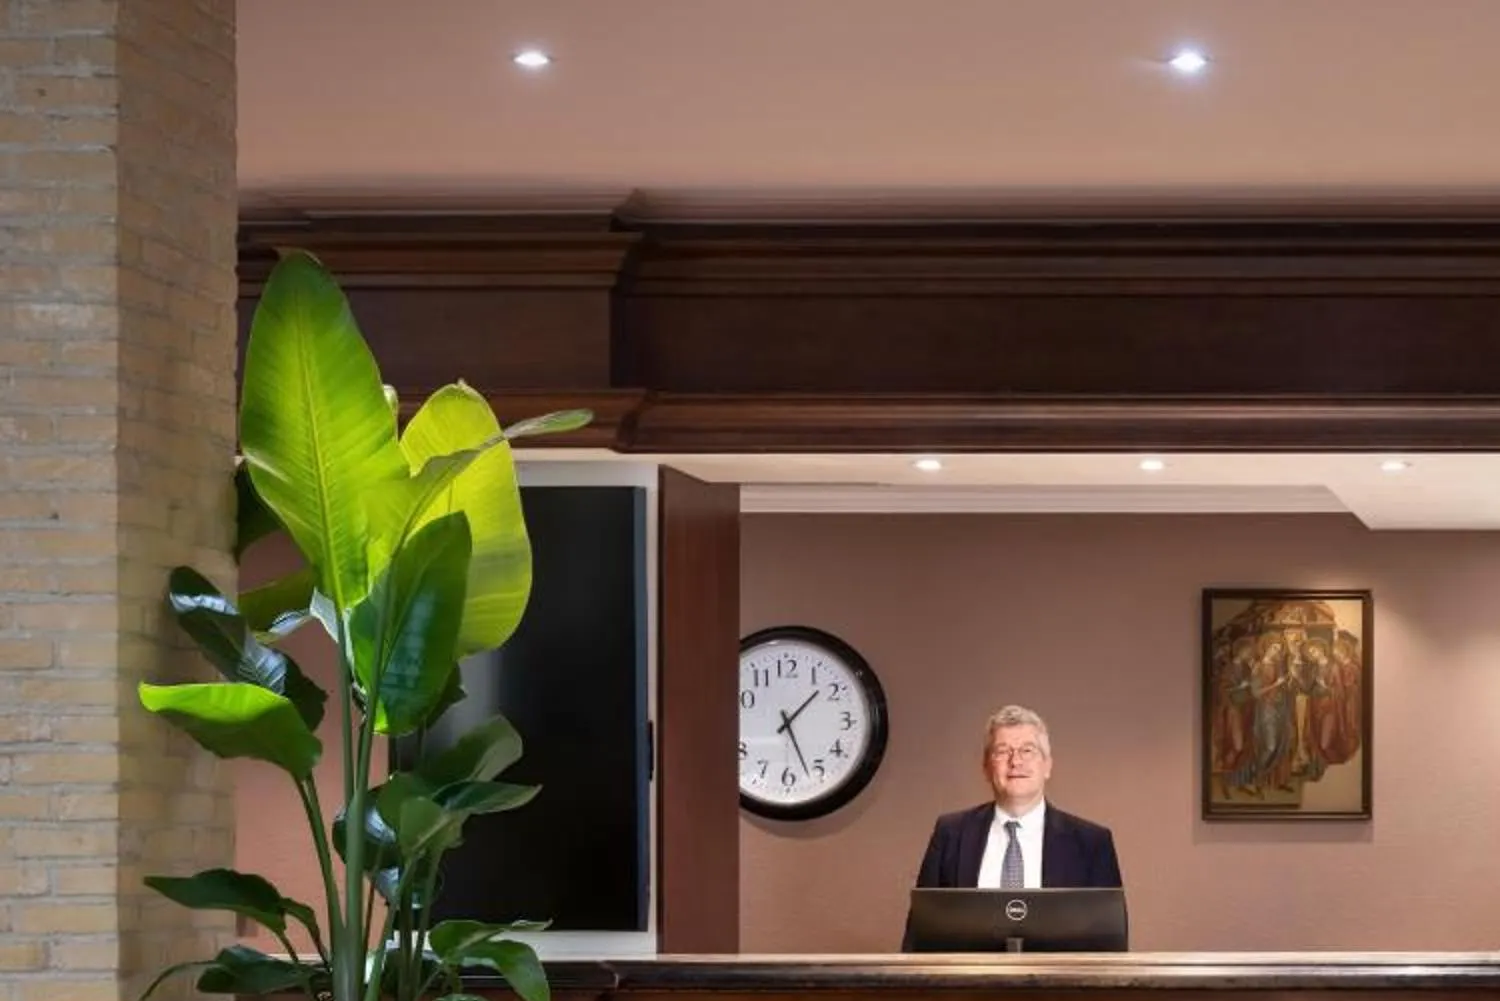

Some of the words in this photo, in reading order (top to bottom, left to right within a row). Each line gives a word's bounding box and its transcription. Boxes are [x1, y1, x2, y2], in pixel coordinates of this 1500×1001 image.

[753, 668, 769, 688] 11
[777, 659, 799, 678] 12
[811, 666, 817, 685] 1
[741, 689, 755, 709] 0
[827, 682, 841, 701] 2
[840, 711, 851, 731] 3
[829, 738, 843, 758] 4
[757, 759, 768, 779] 7
[781, 767, 796, 787] 6
[812, 759, 825, 779] 5
